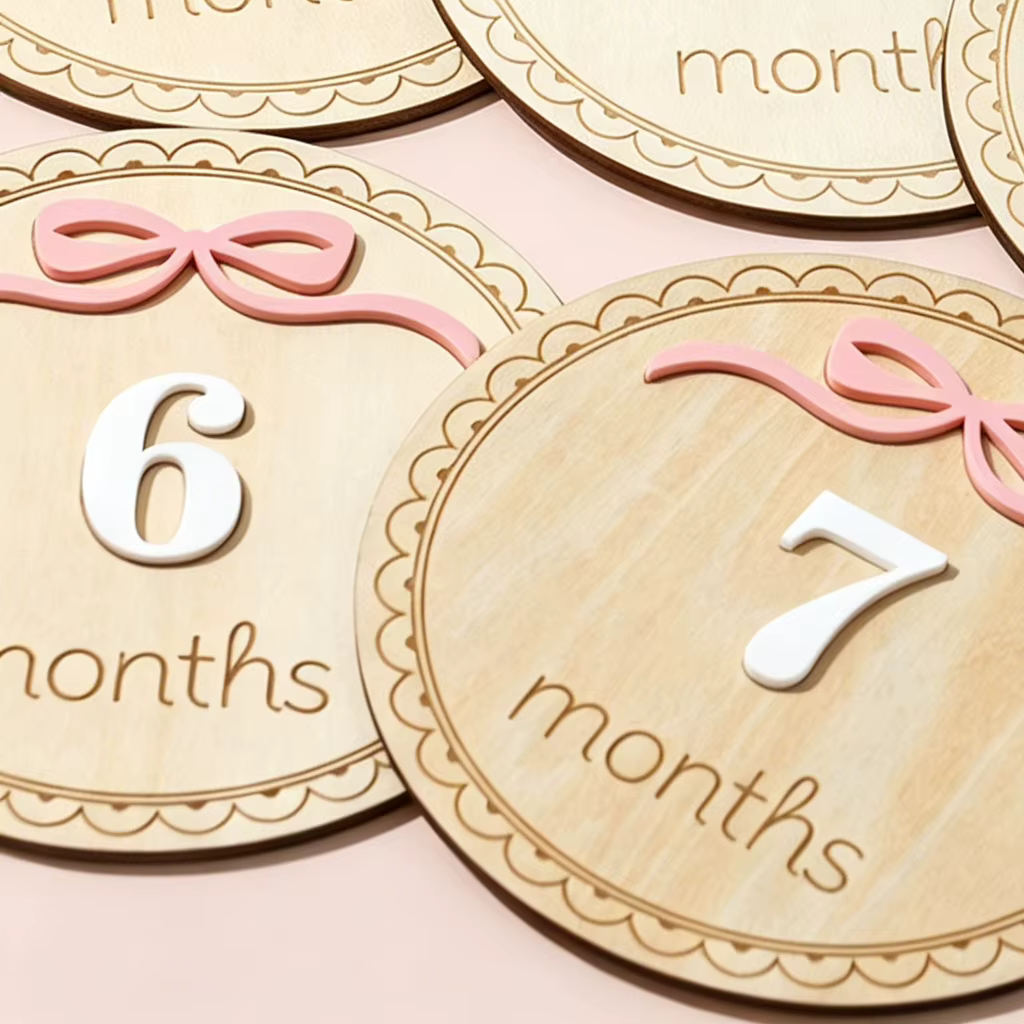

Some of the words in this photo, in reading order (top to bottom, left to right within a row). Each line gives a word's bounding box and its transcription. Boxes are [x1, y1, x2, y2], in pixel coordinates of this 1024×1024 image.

[80, 372, 246, 565] 6
[741, 489, 950, 690] 7
[508, 674, 866, 894] months
